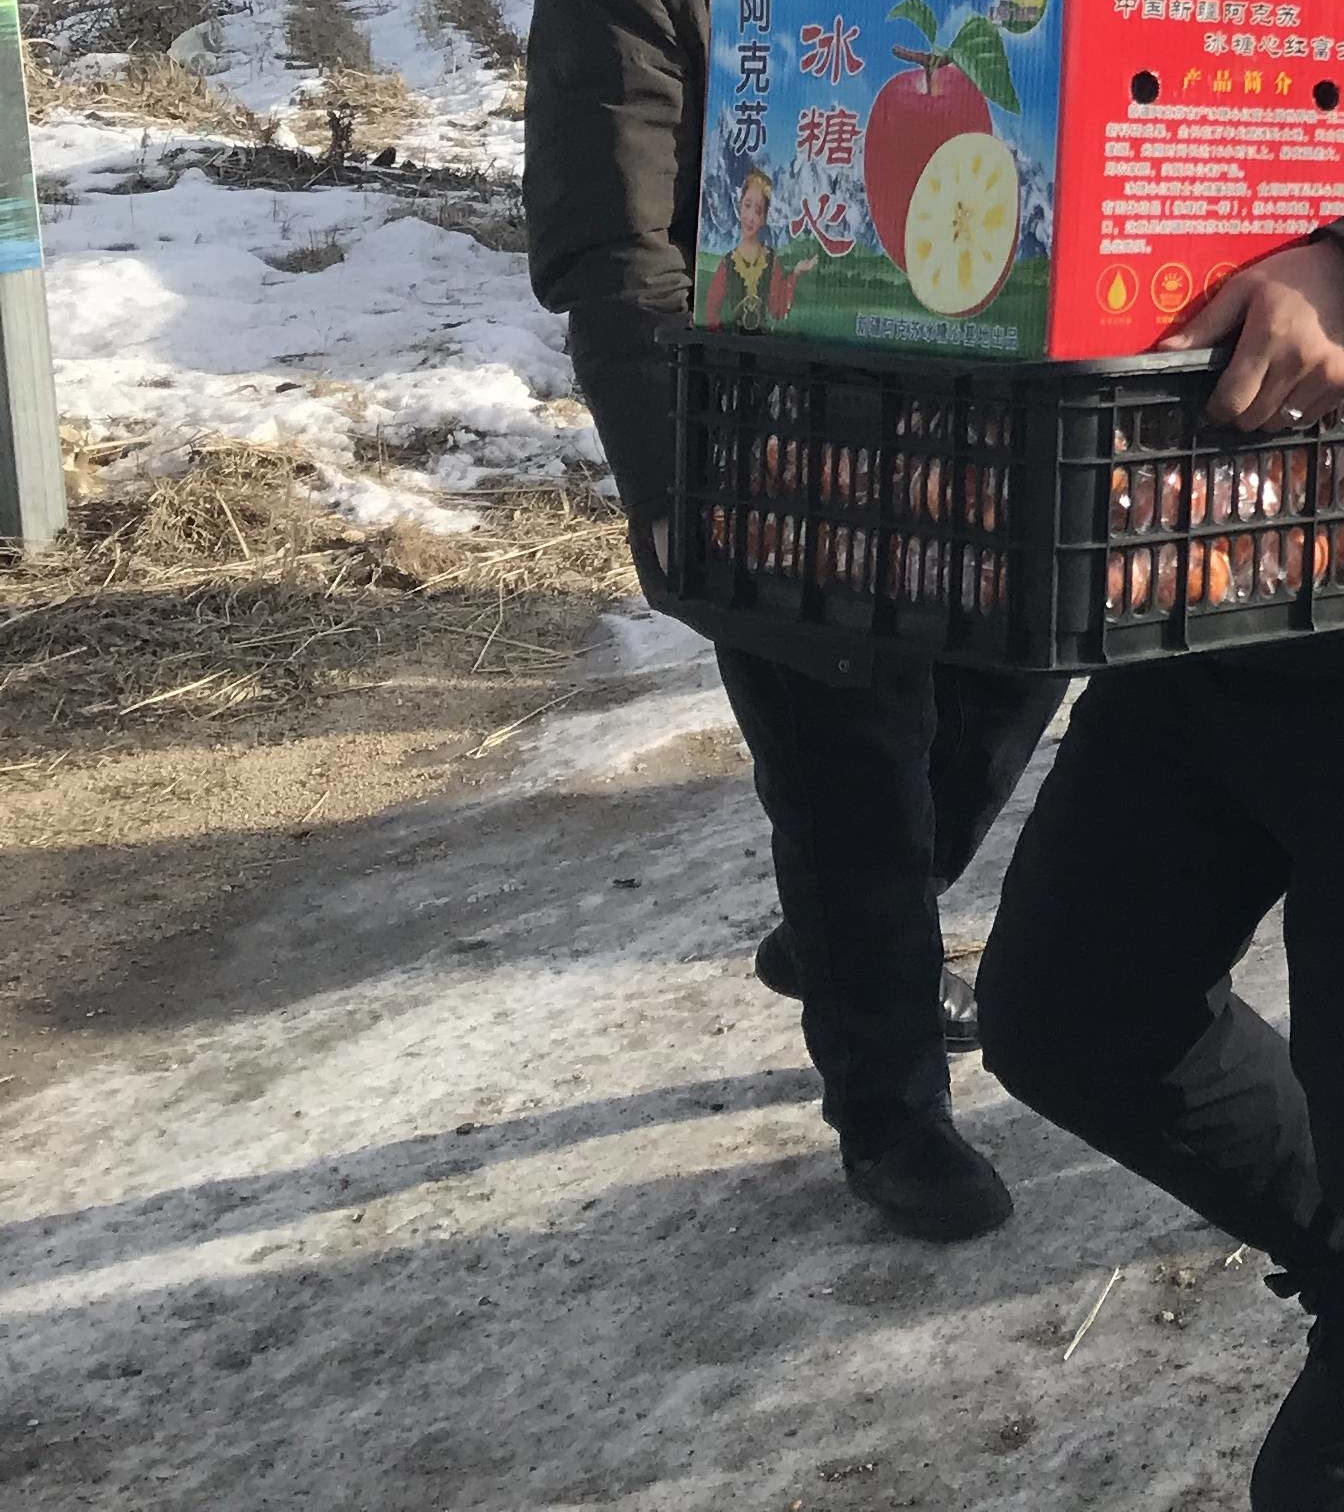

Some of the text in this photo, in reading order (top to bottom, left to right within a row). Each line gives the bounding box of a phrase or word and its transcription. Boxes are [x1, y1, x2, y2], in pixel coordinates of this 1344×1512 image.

[789, 14, 866, 257] 冰糖心
[1182, 68, 1293, 96] 产品简介
